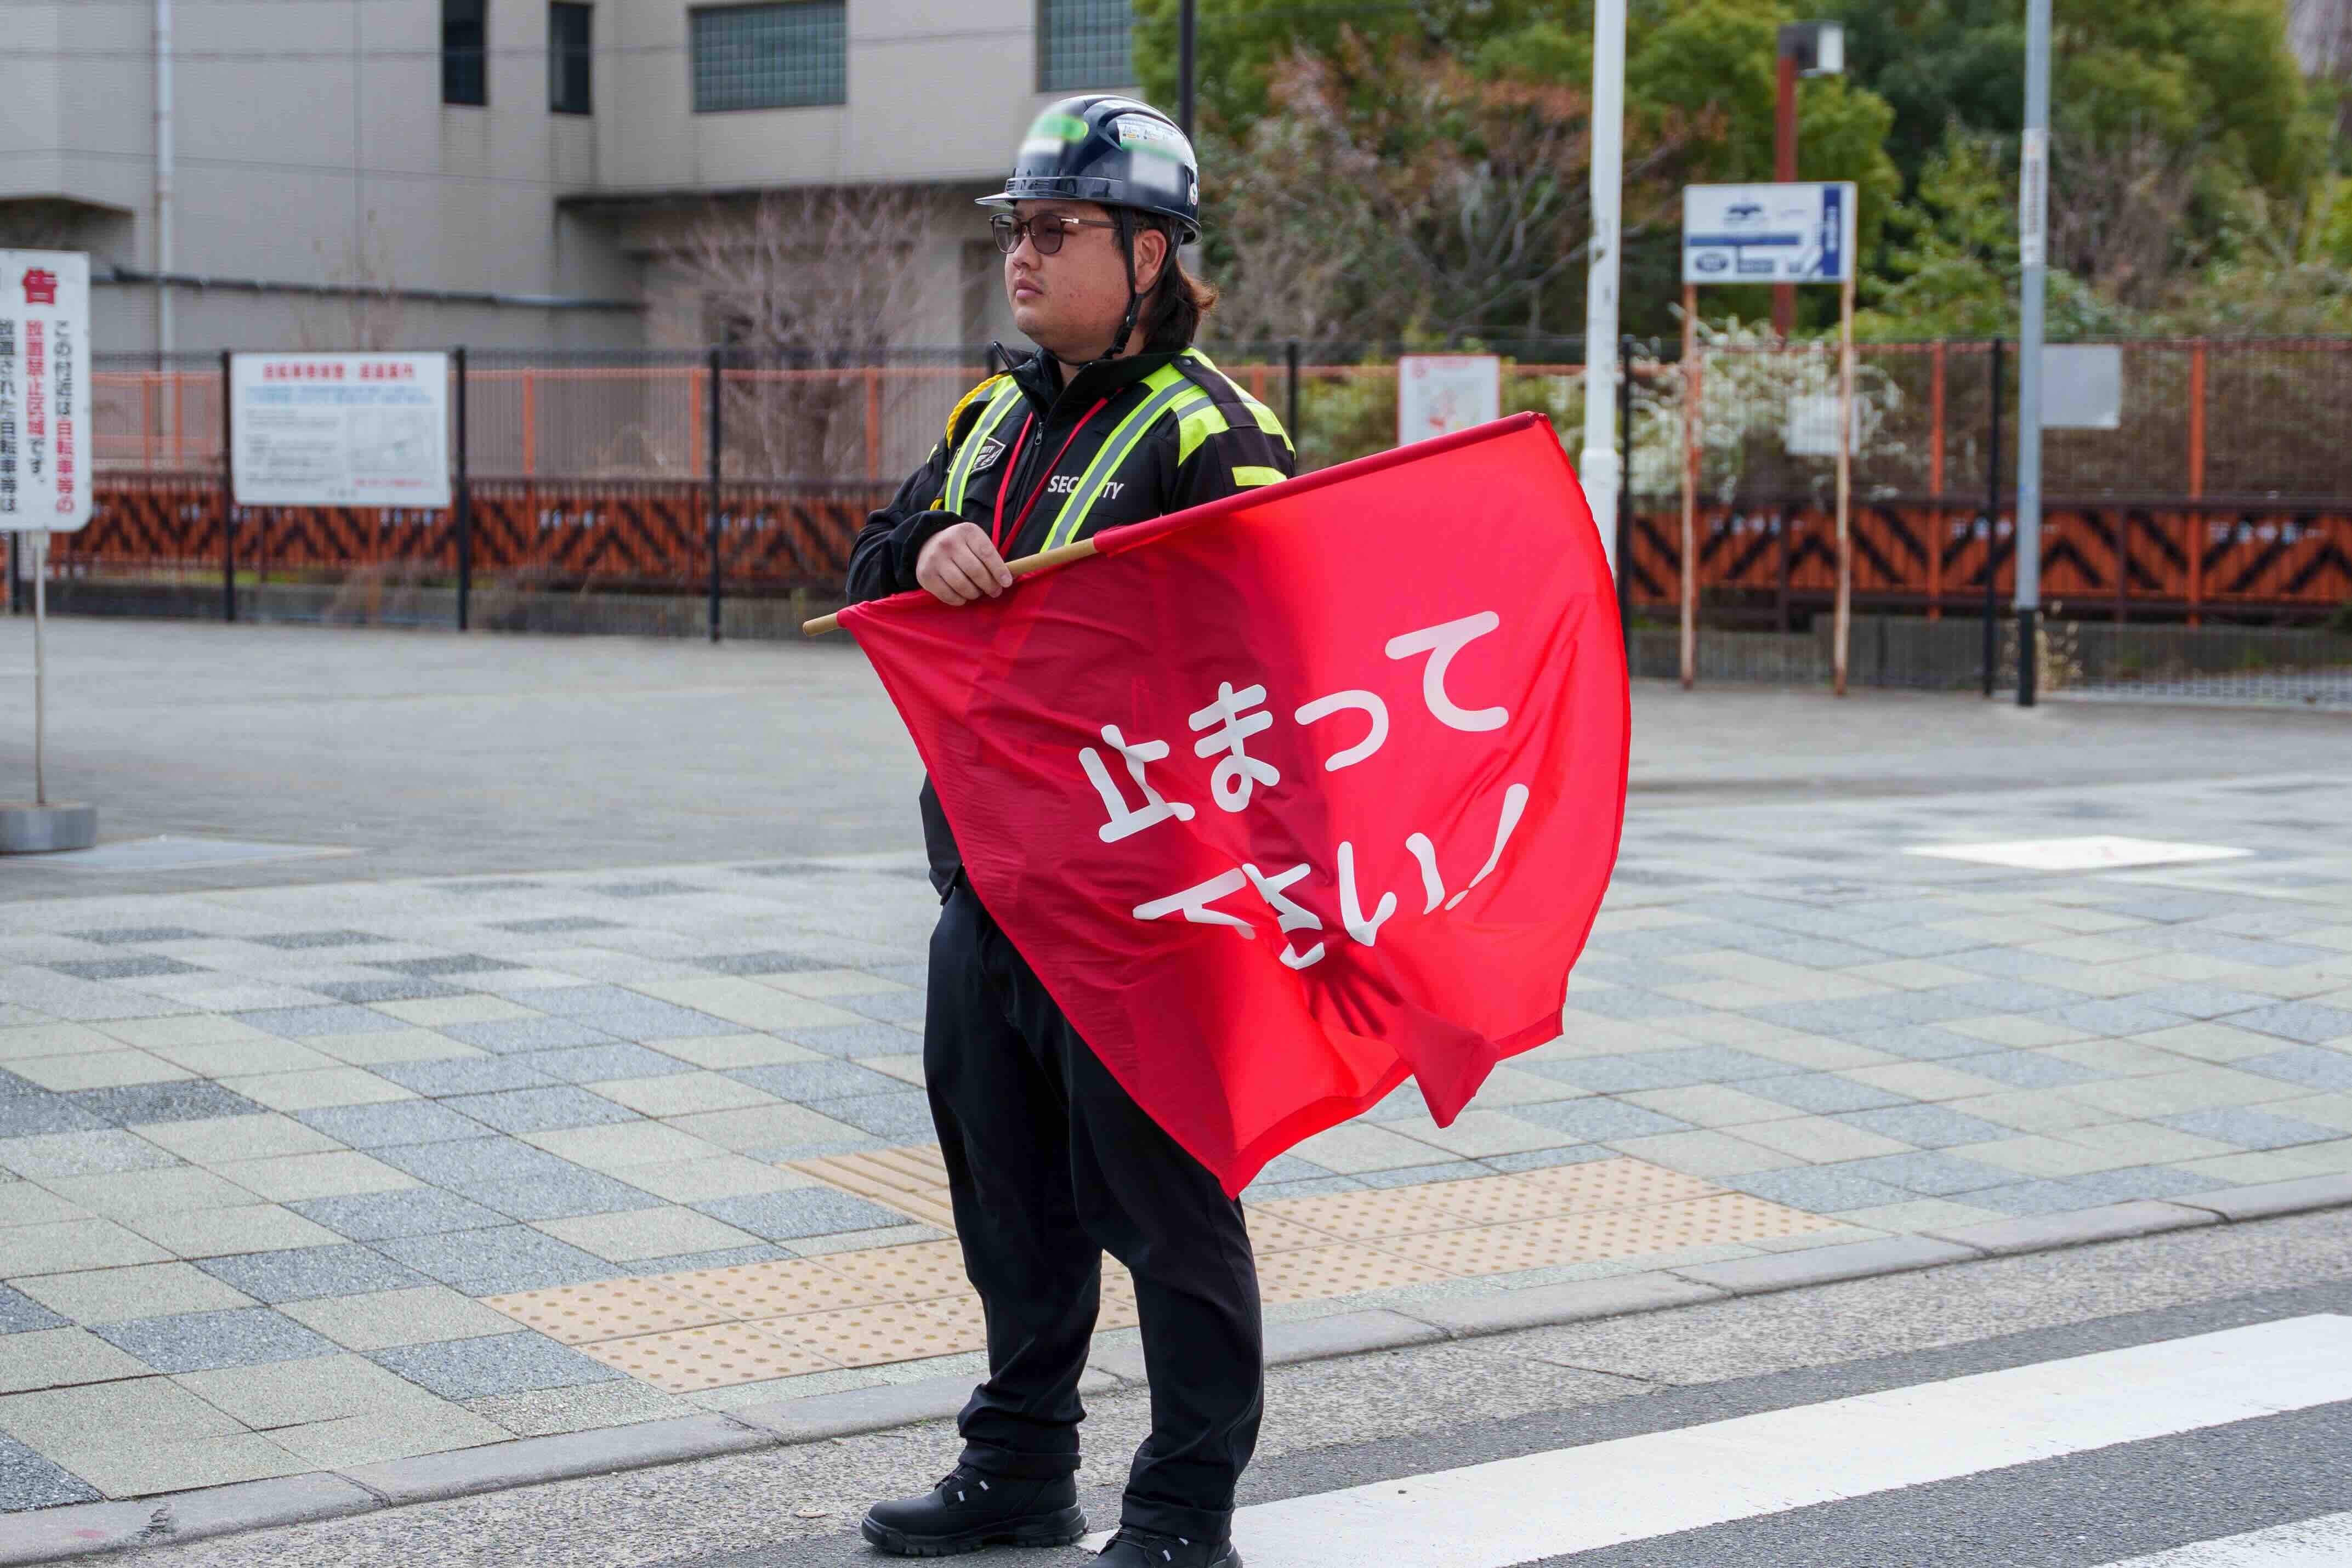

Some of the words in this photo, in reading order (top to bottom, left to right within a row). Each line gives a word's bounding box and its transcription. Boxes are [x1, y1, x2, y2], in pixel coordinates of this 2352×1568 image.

[1048, 475, 1124, 499] SECTY
[1078, 610, 1509, 843] 止まって
